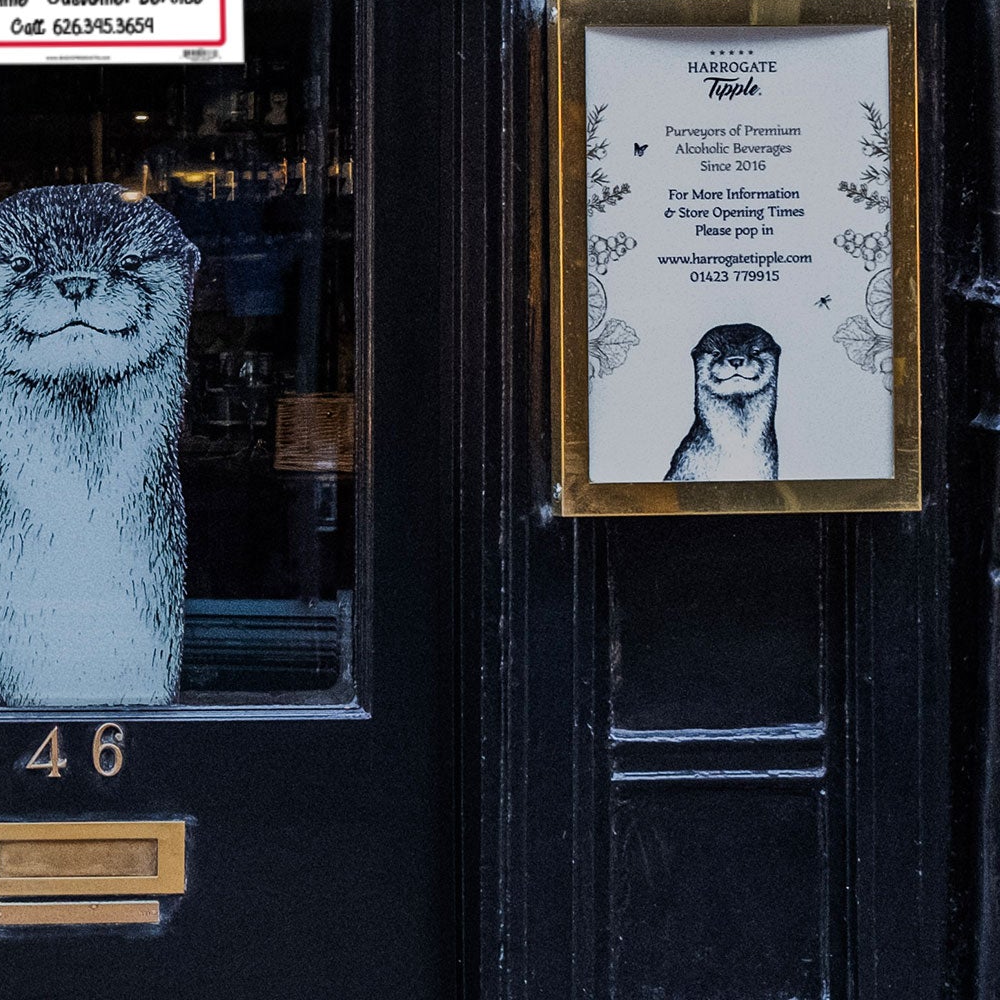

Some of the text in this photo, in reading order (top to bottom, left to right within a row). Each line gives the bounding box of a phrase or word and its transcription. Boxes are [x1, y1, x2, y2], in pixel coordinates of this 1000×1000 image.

[10, 17, 46, 36] Call
[688, 61, 777, 73] HARROGATE
[665, 124, 801, 140] Purveyors of Premium
[675, 142, 792, 157] Alcoholic Beverages
[700, 160, 766, 172] Since 2016
[668, 187, 800, 200] For More Information
[664, 206, 805, 221] & Store Opening Times
[695, 224, 774, 239] Please pop in
[658, 251, 812, 268] www.harrogatetipple.com
[690, 270, 780, 283] 01423 779915
